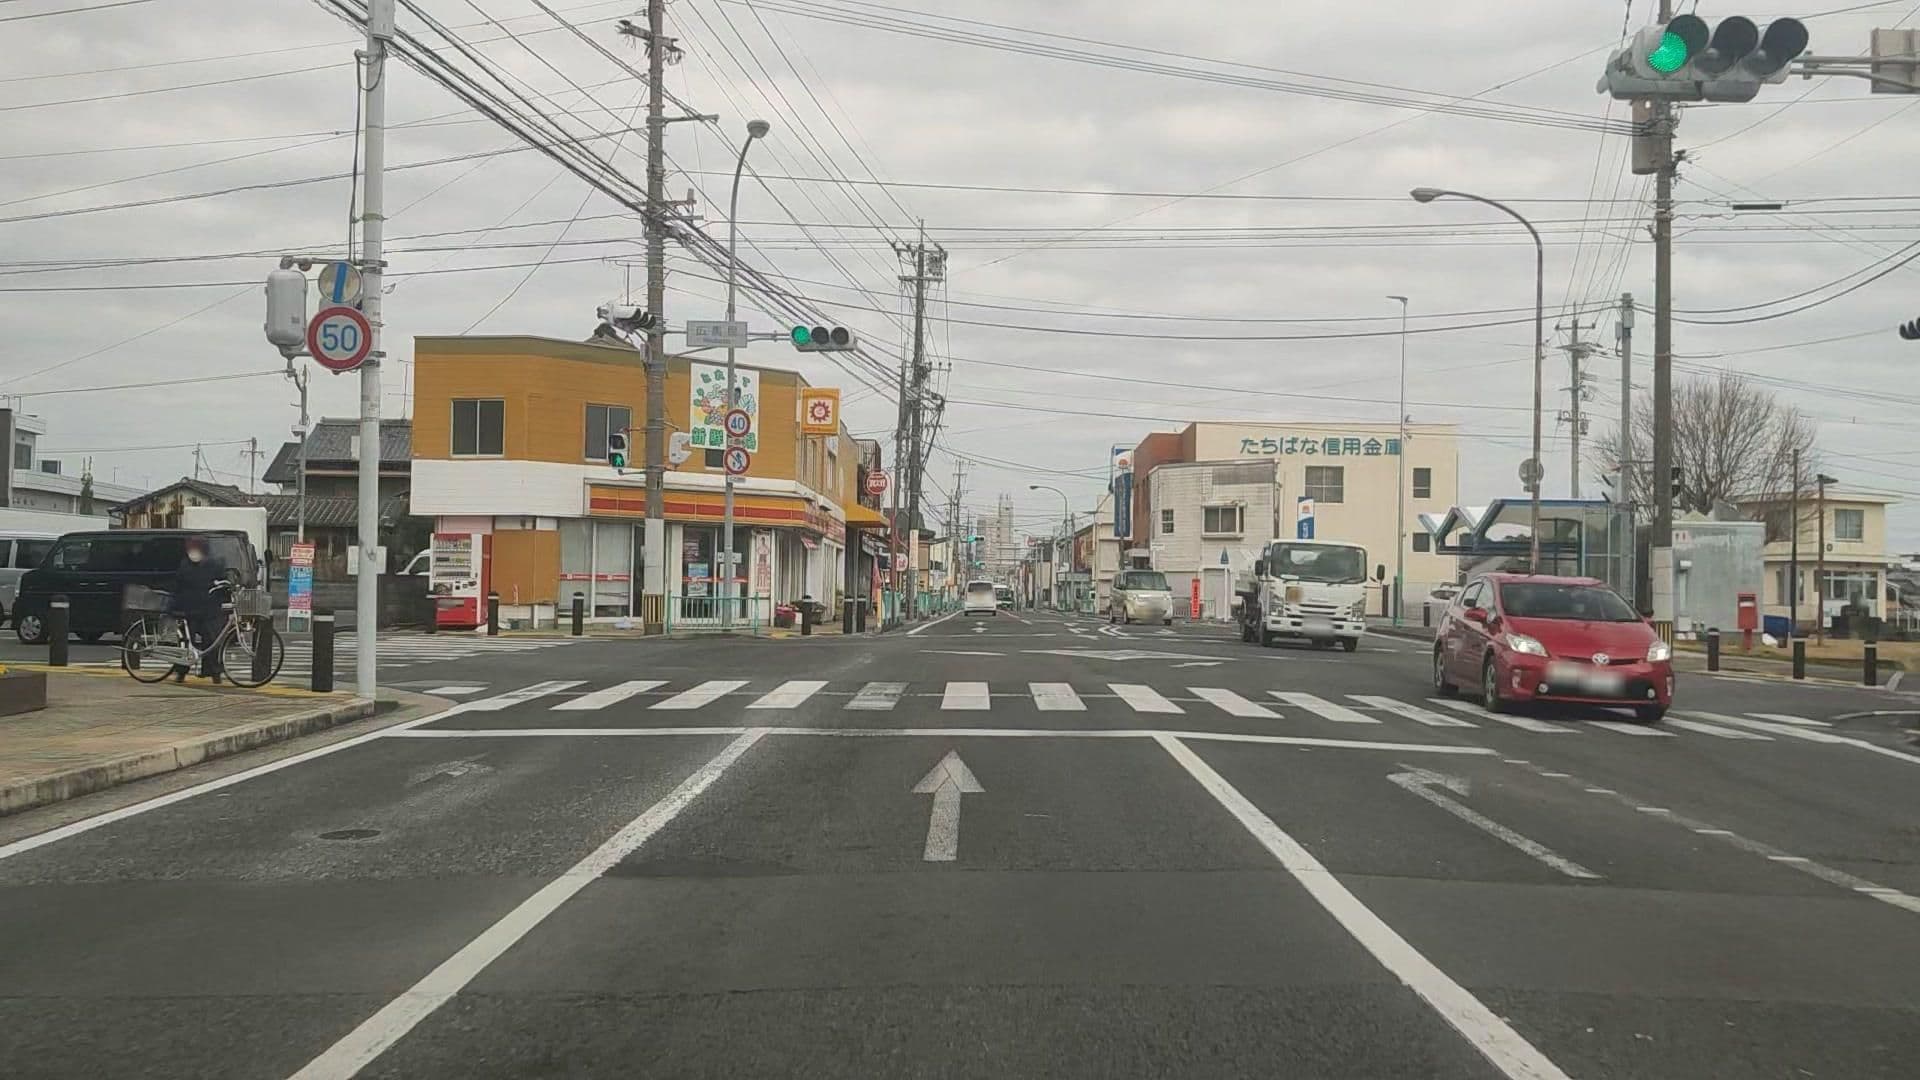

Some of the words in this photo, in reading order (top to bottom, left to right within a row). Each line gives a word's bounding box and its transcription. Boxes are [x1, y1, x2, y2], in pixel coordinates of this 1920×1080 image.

[322, 323, 358, 352] 50
[730, 416, 746, 431] 40
[1240, 437, 1401, 456] たちばな信用金庫
